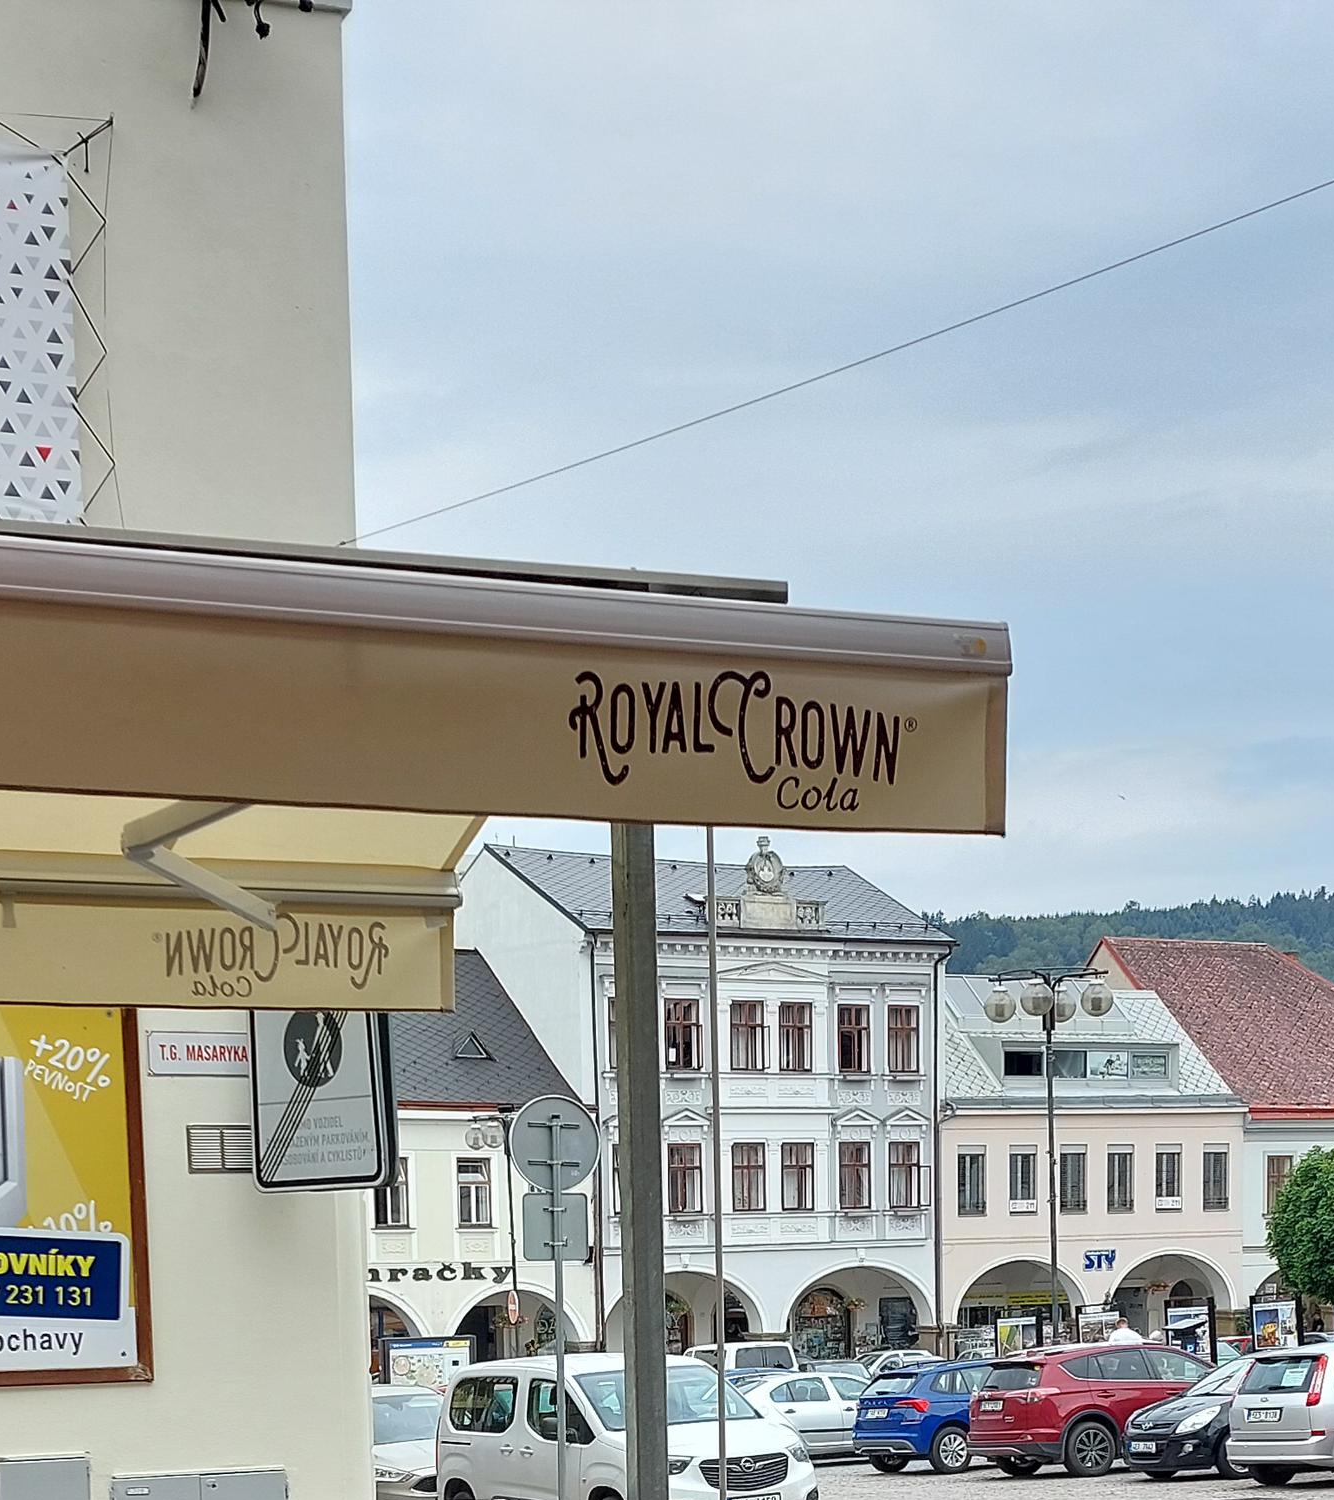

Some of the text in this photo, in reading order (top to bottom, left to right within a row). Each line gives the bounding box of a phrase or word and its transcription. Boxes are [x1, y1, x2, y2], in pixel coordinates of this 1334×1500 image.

[569, 671, 900, 785] ROYAL CROWN
[776, 776, 859, 812] Cola
[28, 1033, 112, 1088] +20%
[186, 1045, 249, 1062] MASARYKA
[6, 1285, 44, 1305] 231
[55, 1286, 92, 1307] 131
